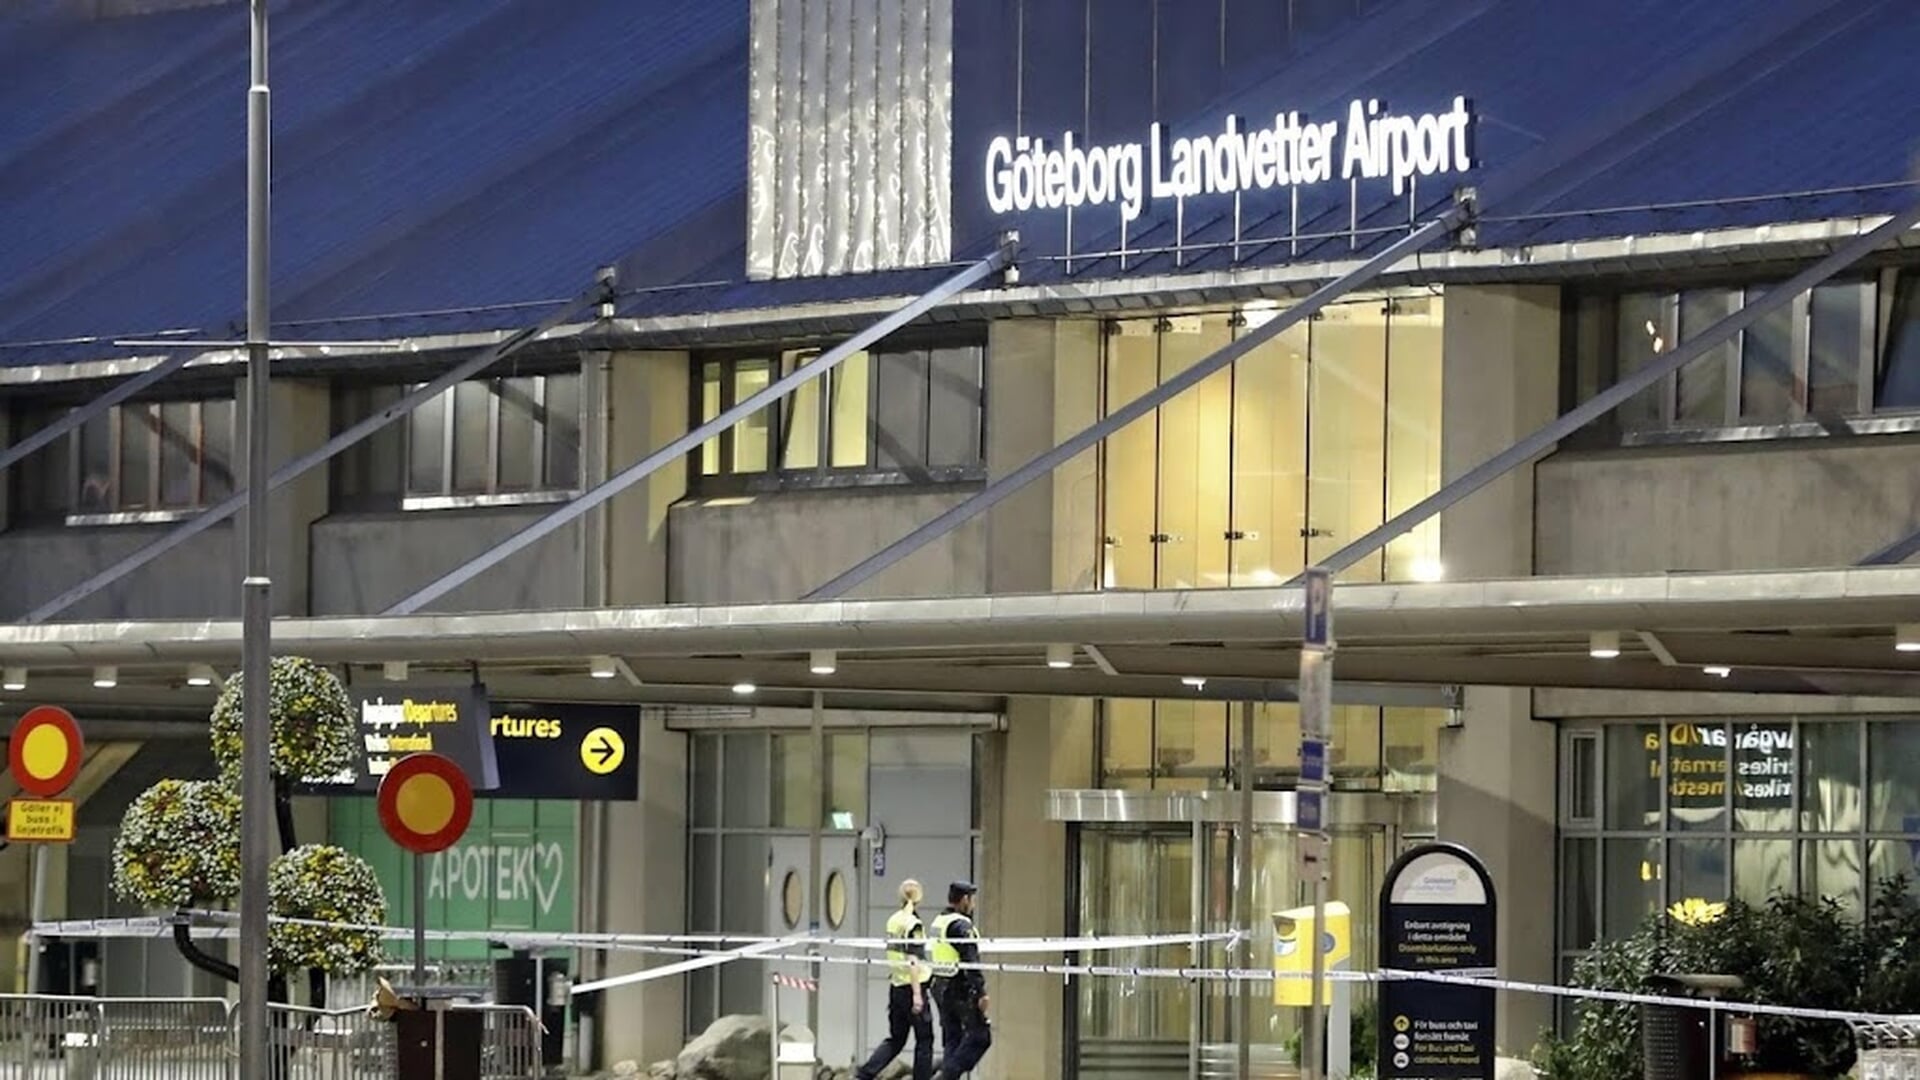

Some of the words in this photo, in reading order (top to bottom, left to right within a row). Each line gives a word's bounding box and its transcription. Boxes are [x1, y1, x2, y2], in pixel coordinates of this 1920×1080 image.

[985, 131, 1143, 221] Göteborg
[1151, 111, 1337, 199] Landvetter
[1342, 96, 1471, 195] Airport
[489, 714, 562, 739] rtures
[26, 814, 50, 824] buss
[428, 845, 529, 900] APOTEK
[1404, 920, 1430, 930] Enbart
[1412, 932, 1433, 941] detta
[1414, 1020, 1427, 1029] För
[1428, 1020, 1446, 1030] buss
[1447, 1020, 1462, 1030] och
[1463, 1021, 1478, 1030] taxi
